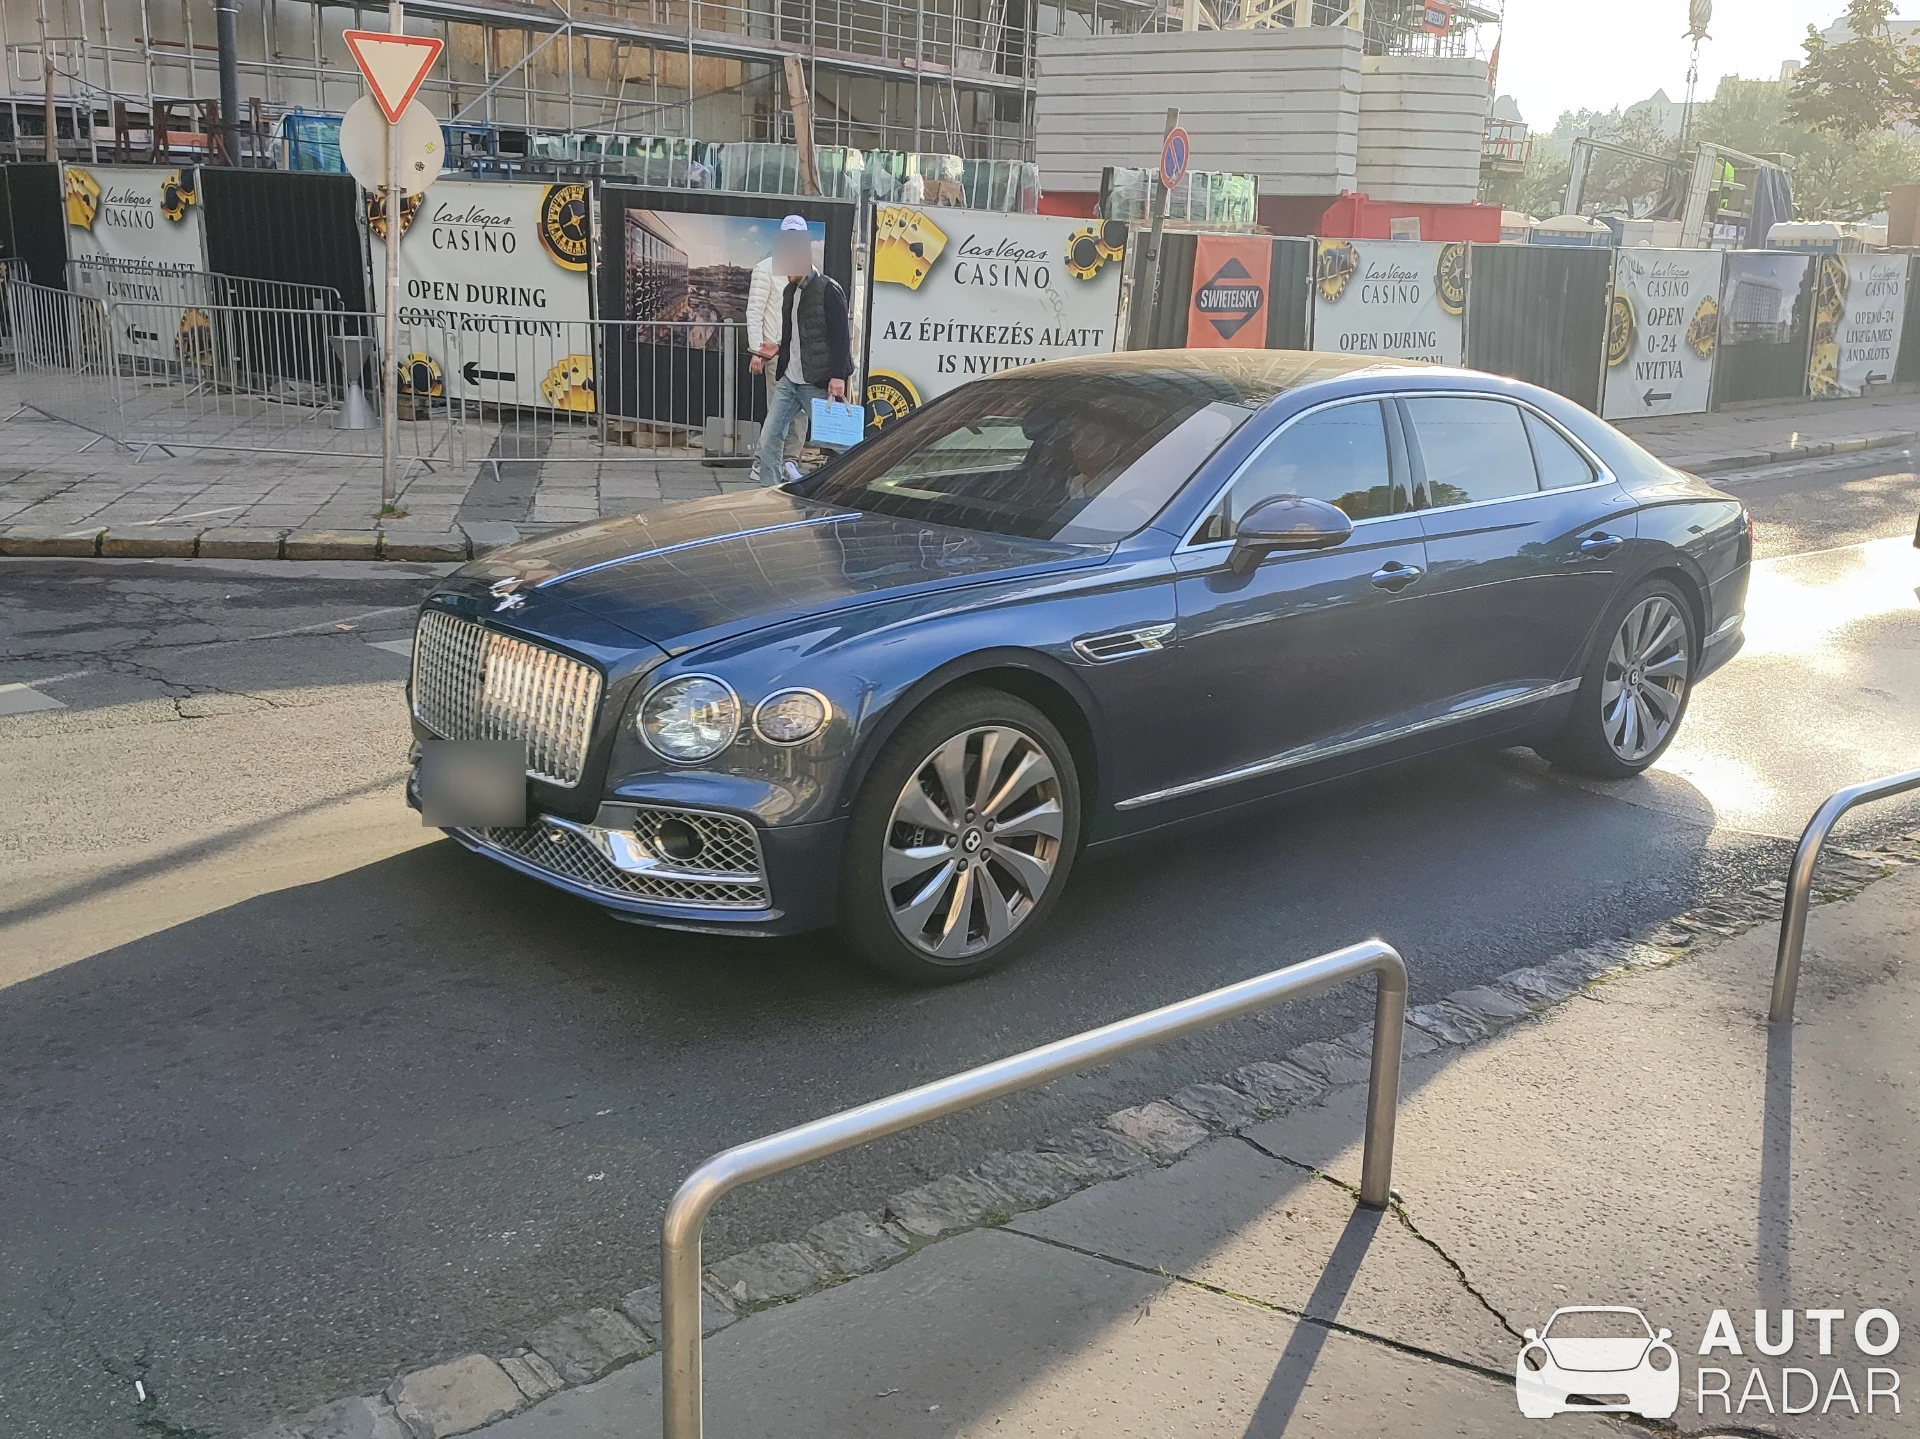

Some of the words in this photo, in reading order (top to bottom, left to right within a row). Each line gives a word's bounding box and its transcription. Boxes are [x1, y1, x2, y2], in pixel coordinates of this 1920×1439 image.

[105, 208, 154, 229] CASINO
[432, 227, 516, 254] CASINO
[79, 254, 93, 269] AZ
[156, 262, 195, 278] ALATT
[954, 261, 1050, 289] CASINO
[107, 281, 118, 296] IS
[407, 279, 459, 302] OPEN
[465, 283, 547, 308] DURING
[1200, 289, 1260, 308] SWIETELSKY
[1361, 284, 1420, 304] CASINO
[1647, 281, 1689, 297] CASINO
[1865, 281, 1899, 297] CASINO
[399, 306, 561, 338] CONSTRUCTION!
[1647, 307, 1684, 327] OPEN
[883, 320, 912, 341] AZ
[918, 317, 1034, 346] ÉPÍTKEZÉS
[1038, 327, 1104, 347] ALATT
[1339, 333, 1378, 351] OPEN
[1383, 331, 1437, 349] DURING
[1647, 335, 1677, 353] 0-24
[937, 354, 957, 373] IS
[1846, 348, 1865, 363] AND
[1865, 347, 1890, 361] SLOTS
[1635, 360, 1683, 381] NYITVA
